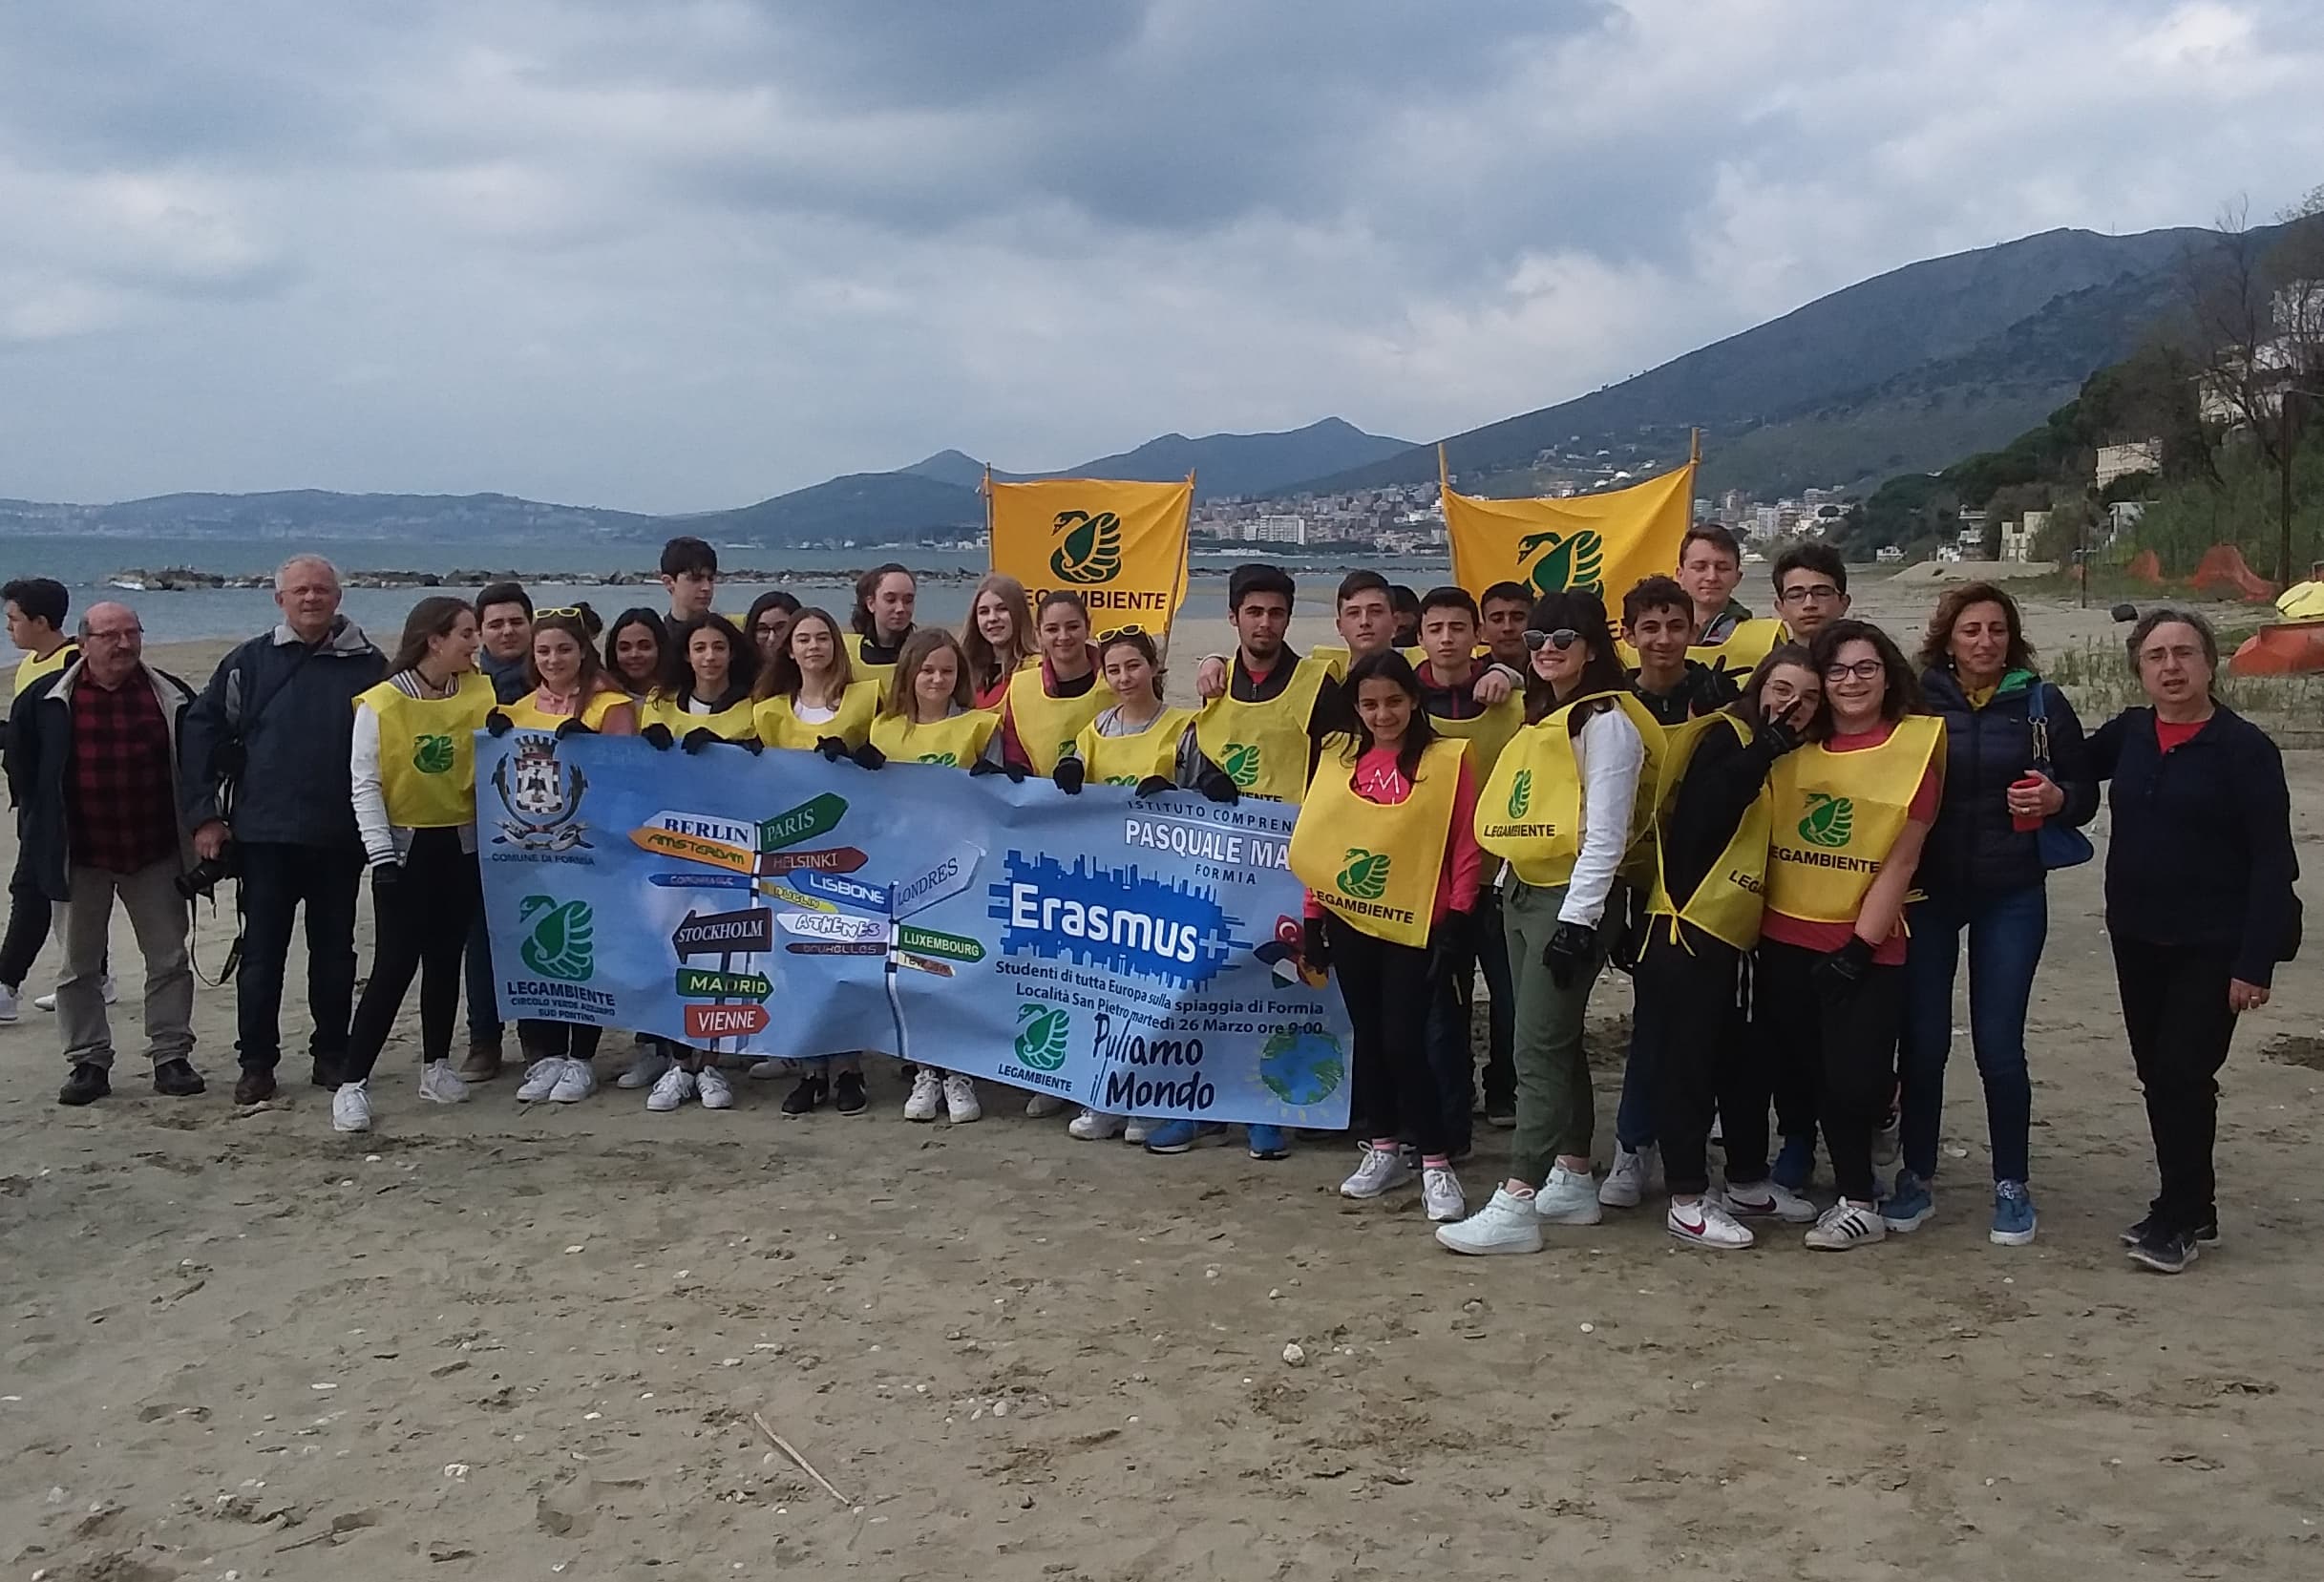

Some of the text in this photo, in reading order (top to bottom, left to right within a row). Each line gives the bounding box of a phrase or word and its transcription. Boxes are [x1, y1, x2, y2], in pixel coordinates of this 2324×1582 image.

[664, 817, 749, 843] BERLIN
[766, 809, 816, 842] PARIS
[1127, 800, 1291, 832] ISTITUTO COMPREN
[1125, 818, 1291, 871] PASQUALE MA
[773, 853, 838, 869] HELSINKI
[1194, 863, 1257, 884] FORMIA
[1770, 845, 1880, 874] EGAMBIENTE
[810, 873, 885, 904] LISBONE
[898, 857, 958, 906] LONDRES
[1728, 870, 1764, 896] LEG
[678, 920, 764, 943] STOCKHOLM
[795, 914, 880, 939] ATHENES
[1011, 882, 1229, 963] Erasmus+
[904, 931, 980, 956] LUXEMBOURG
[507, 981, 616, 1006] LEGAMBIENTE
[689, 976, 768, 994] MADRID
[995, 960, 1323, 1015] Studenti di tutta Europa sulla spiaggia di Formia
[539, 1008, 557, 1017] SUD
[698, 1011, 756, 1032] VIENNE
[1016, 982, 1070, 1002] Località
[1072, 992, 1095, 1009] San
[1097, 998, 1130, 1019] Pietro
[1178, 1019, 1199, 1031] 26
[1203, 1019, 1254, 1033] Marzo
[1257, 1023, 1284, 1034] ore
[1093, 1012, 1204, 1066] Puliamo
[998, 1064, 1073, 1092] LEGAMBIENTE
[1106, 1070, 1215, 1111] Mondo
